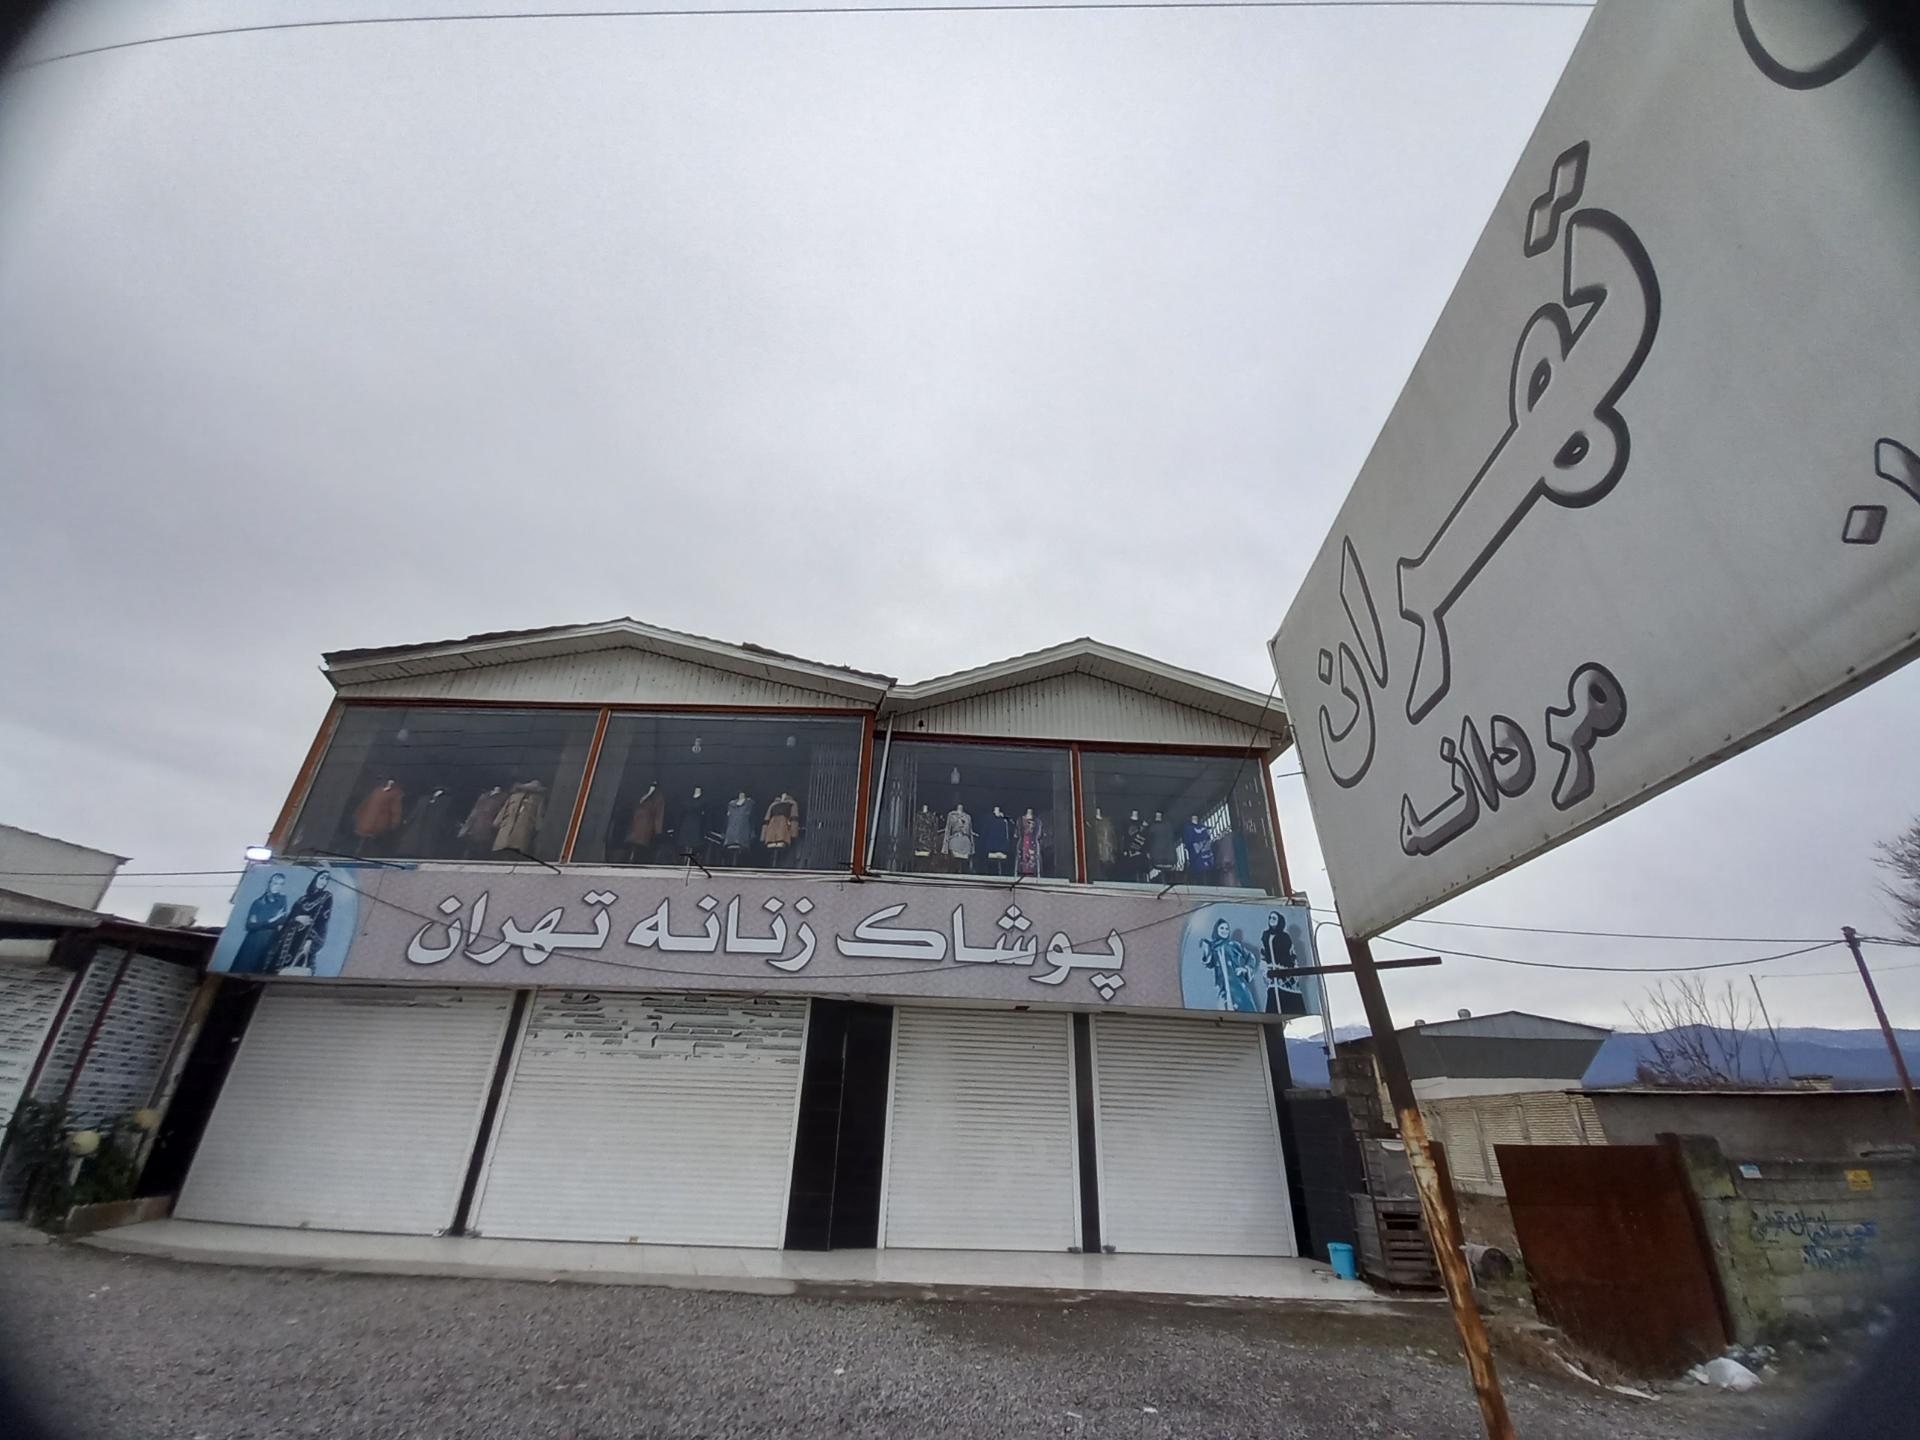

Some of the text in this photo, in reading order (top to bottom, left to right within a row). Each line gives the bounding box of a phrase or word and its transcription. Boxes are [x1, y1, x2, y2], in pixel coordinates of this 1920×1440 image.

[1318, 140, 1661, 789] تهران
[1400, 661, 1628, 857] مردانه
[405, 889, 1127, 1000] پوشاک زنانه تهران
